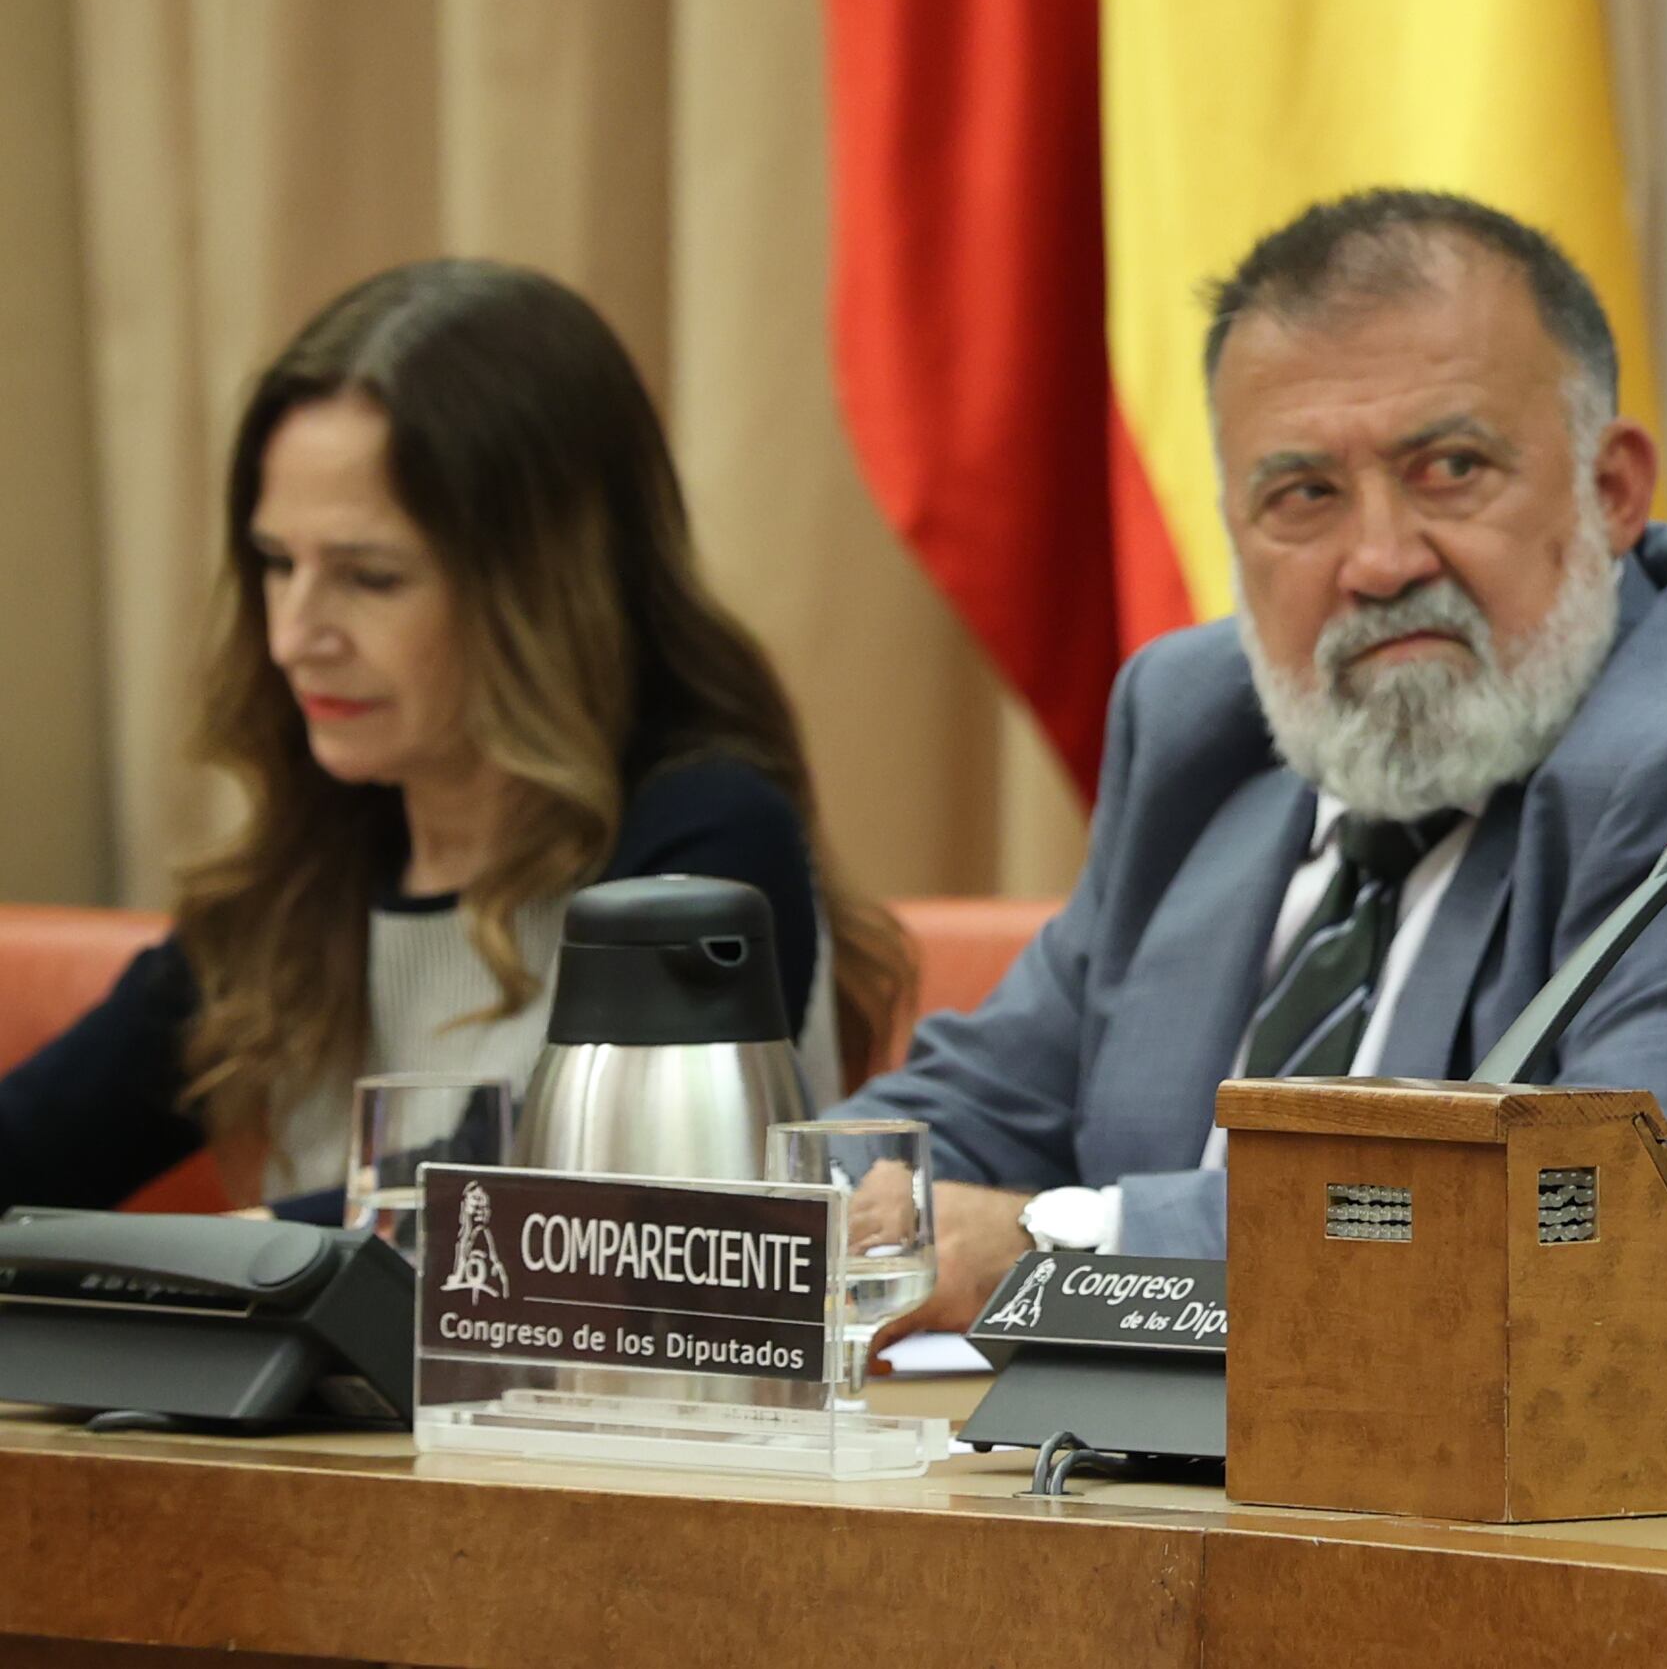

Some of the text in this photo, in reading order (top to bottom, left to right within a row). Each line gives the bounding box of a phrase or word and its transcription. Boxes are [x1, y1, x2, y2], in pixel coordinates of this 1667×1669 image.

[521, 1213, 812, 1293] COMPARECIENTE
[1061, 1265, 1195, 1305] Congreso
[439, 1311, 804, 1370] Congreso de los Diputados
[1120, 1310, 1144, 1330] de
[1143, 1311, 1170, 1331] los
